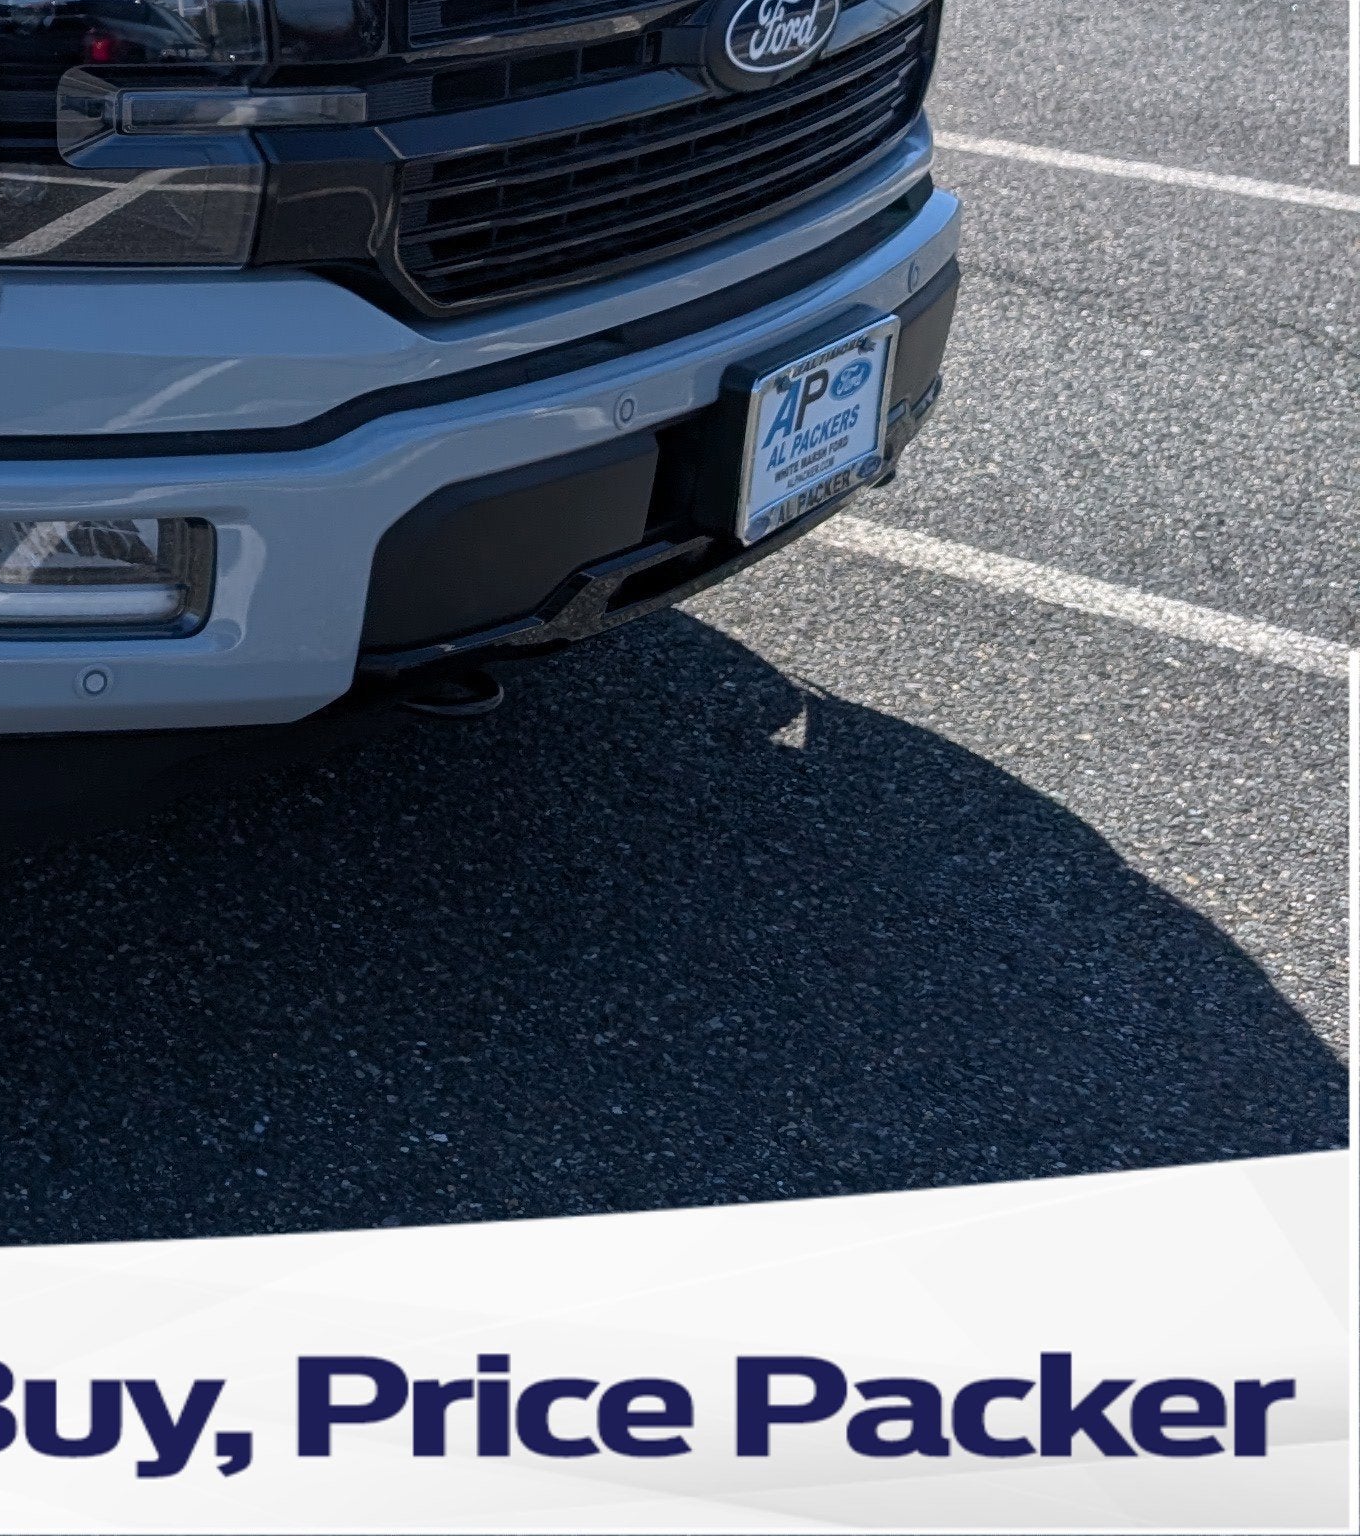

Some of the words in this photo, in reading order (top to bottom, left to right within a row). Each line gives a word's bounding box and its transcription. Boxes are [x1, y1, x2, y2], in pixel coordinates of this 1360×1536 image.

[761, 368, 829, 450] AP
[766, 441, 786, 472] AL
[790, 404, 860, 459] PACKERS
